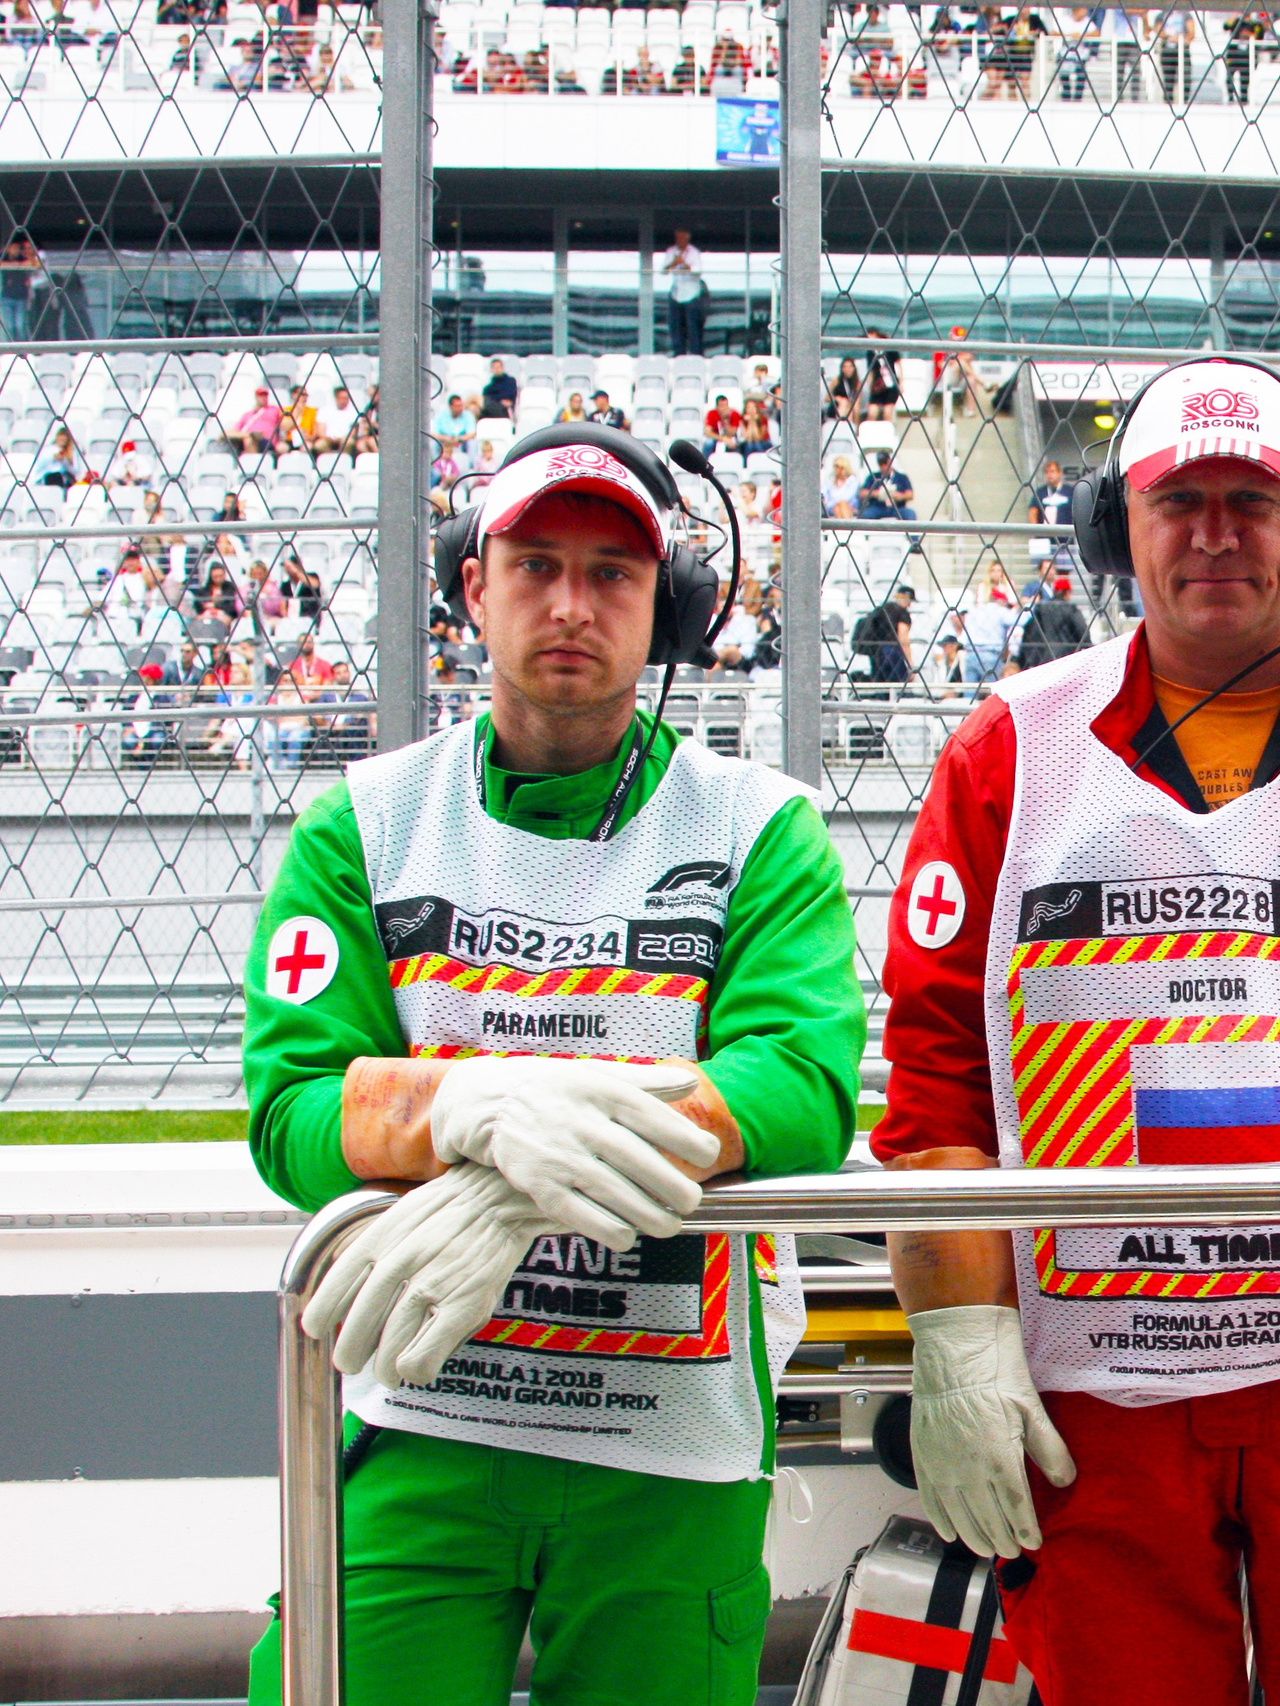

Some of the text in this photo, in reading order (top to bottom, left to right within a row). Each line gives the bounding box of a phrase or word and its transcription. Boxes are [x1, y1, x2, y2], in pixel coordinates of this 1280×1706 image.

[1041, 373, 1101, 389] 203
[1181, 388, 1260, 422] ROS
[1181, 419, 1260, 433] ROSGONKI
[623, 748, 639, 781] SOCHI
[1198, 769, 1227, 780] CAST
[1107, 887, 1270, 925] RUS2228
[455, 918, 621, 963] RUS2234
[1169, 977, 1248, 1002] DOCTOR
[483, 1011, 607, 1038] PARAMEDIC
[519, 1236, 642, 1277] ANE
[1118, 1234, 1186, 1264] ALL
[1133, 1314, 1235, 1331] FORMULA
[1236, 1312, 1251, 1328] 1
[1088, 1333, 1130, 1349] VTB
[1132, 1332, 1222, 1350] RUSSIAN
[441, 1358, 605, 1389] RMULA 1 2018
[1135, 1367, 1175, 1375] FORMULA
[1197, 1364, 1231, 1374] WORLD
[514, 1387, 602, 1408] GRAND
[605, 1392, 660, 1411] PRIX
[415, 1405, 459, 1420] FORMULA
[460, 1414, 481, 1423] ONE
[482, 1416, 517, 1428] WORLD
[517, 1421, 593, 1434] CHAMPIONSHIP
[593, 1426, 633, 1435] LIMITED
